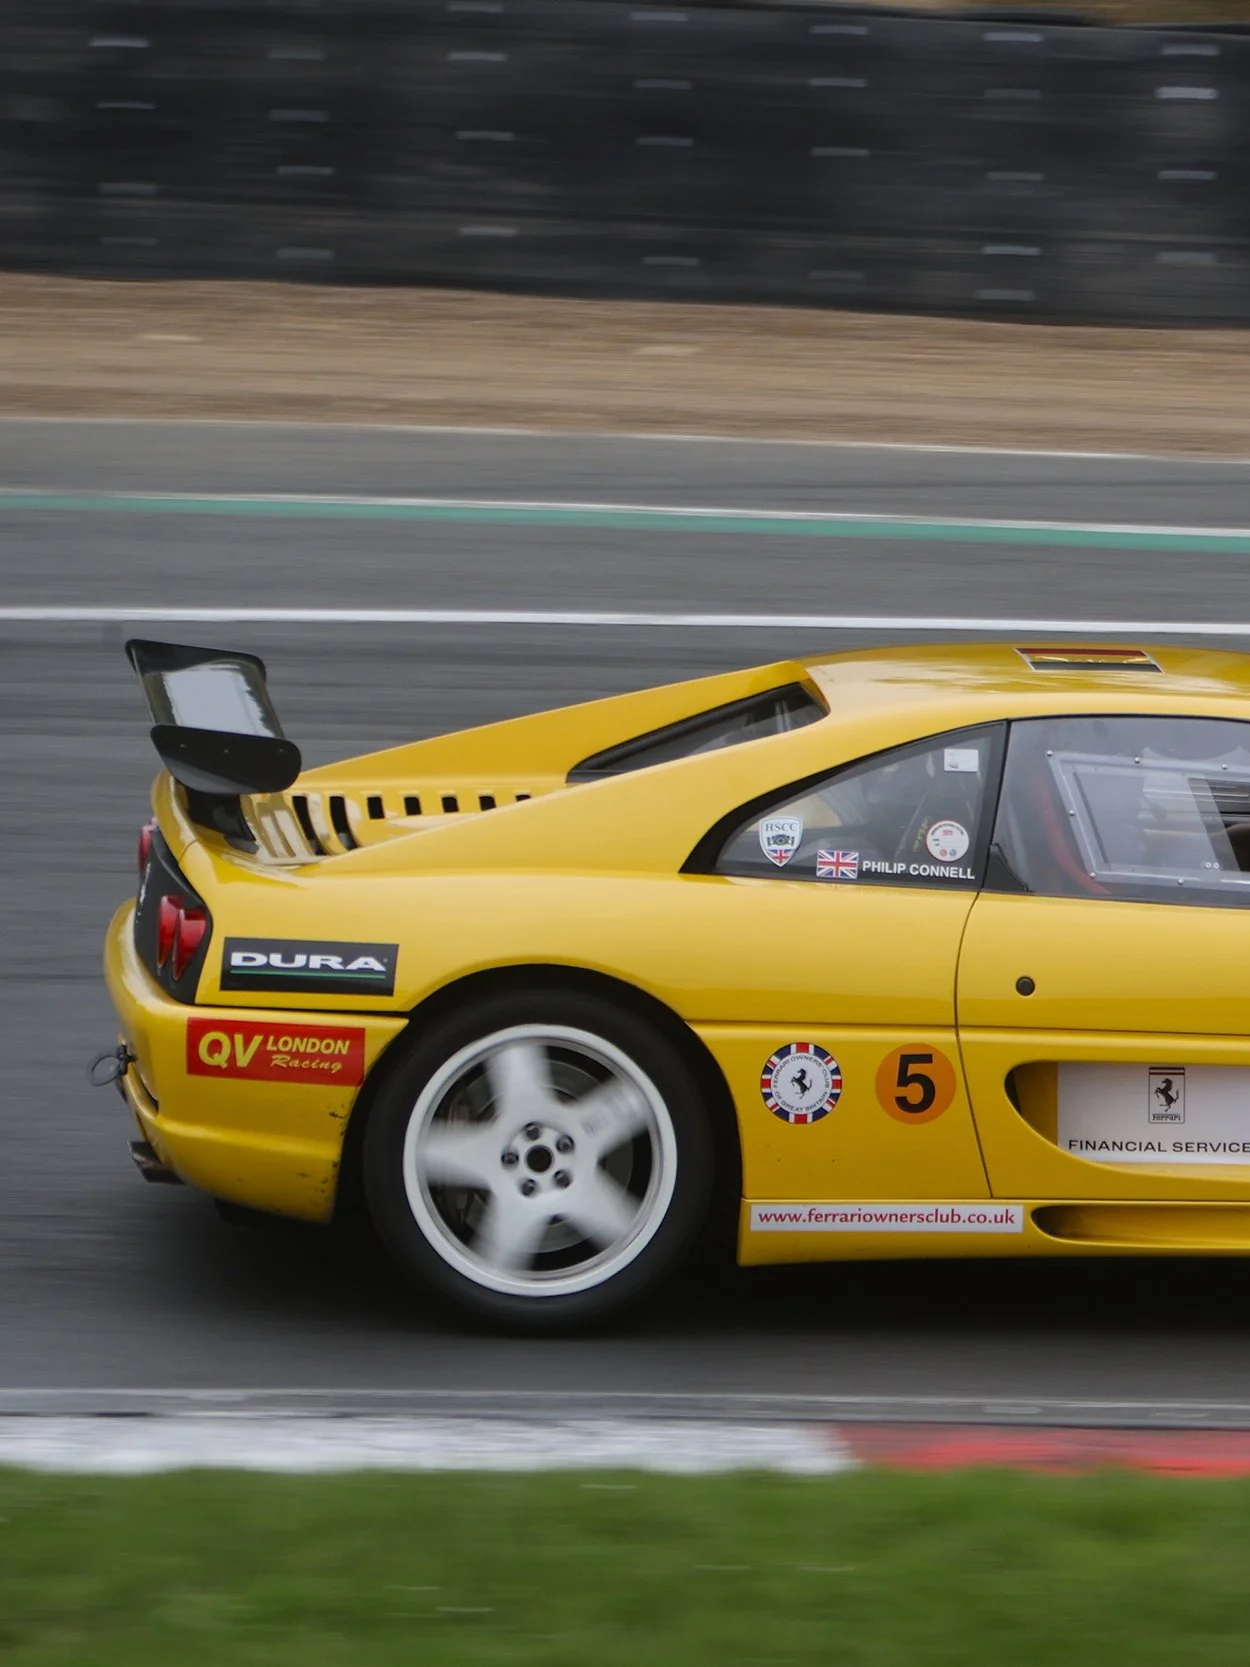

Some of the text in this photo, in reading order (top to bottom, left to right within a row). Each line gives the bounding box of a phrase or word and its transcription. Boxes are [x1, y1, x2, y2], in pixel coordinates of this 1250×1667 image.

[765, 822, 799, 833] HSCC
[862, 859, 976, 880] PHILIP CONNELL
[230, 952, 387, 972] DURA
[198, 1031, 351, 1069] QV LONDON
[270, 1054, 342, 1074] Racing
[772, 1058, 790, 1089] FERRARI
[894, 1053, 936, 1114] 5
[780, 1101, 804, 1113] GREAT
[1068, 1139, 1167, 1153] FINANCIAL
[758, 1208, 1015, 1225] www.ferrariownersclub.co.uk
